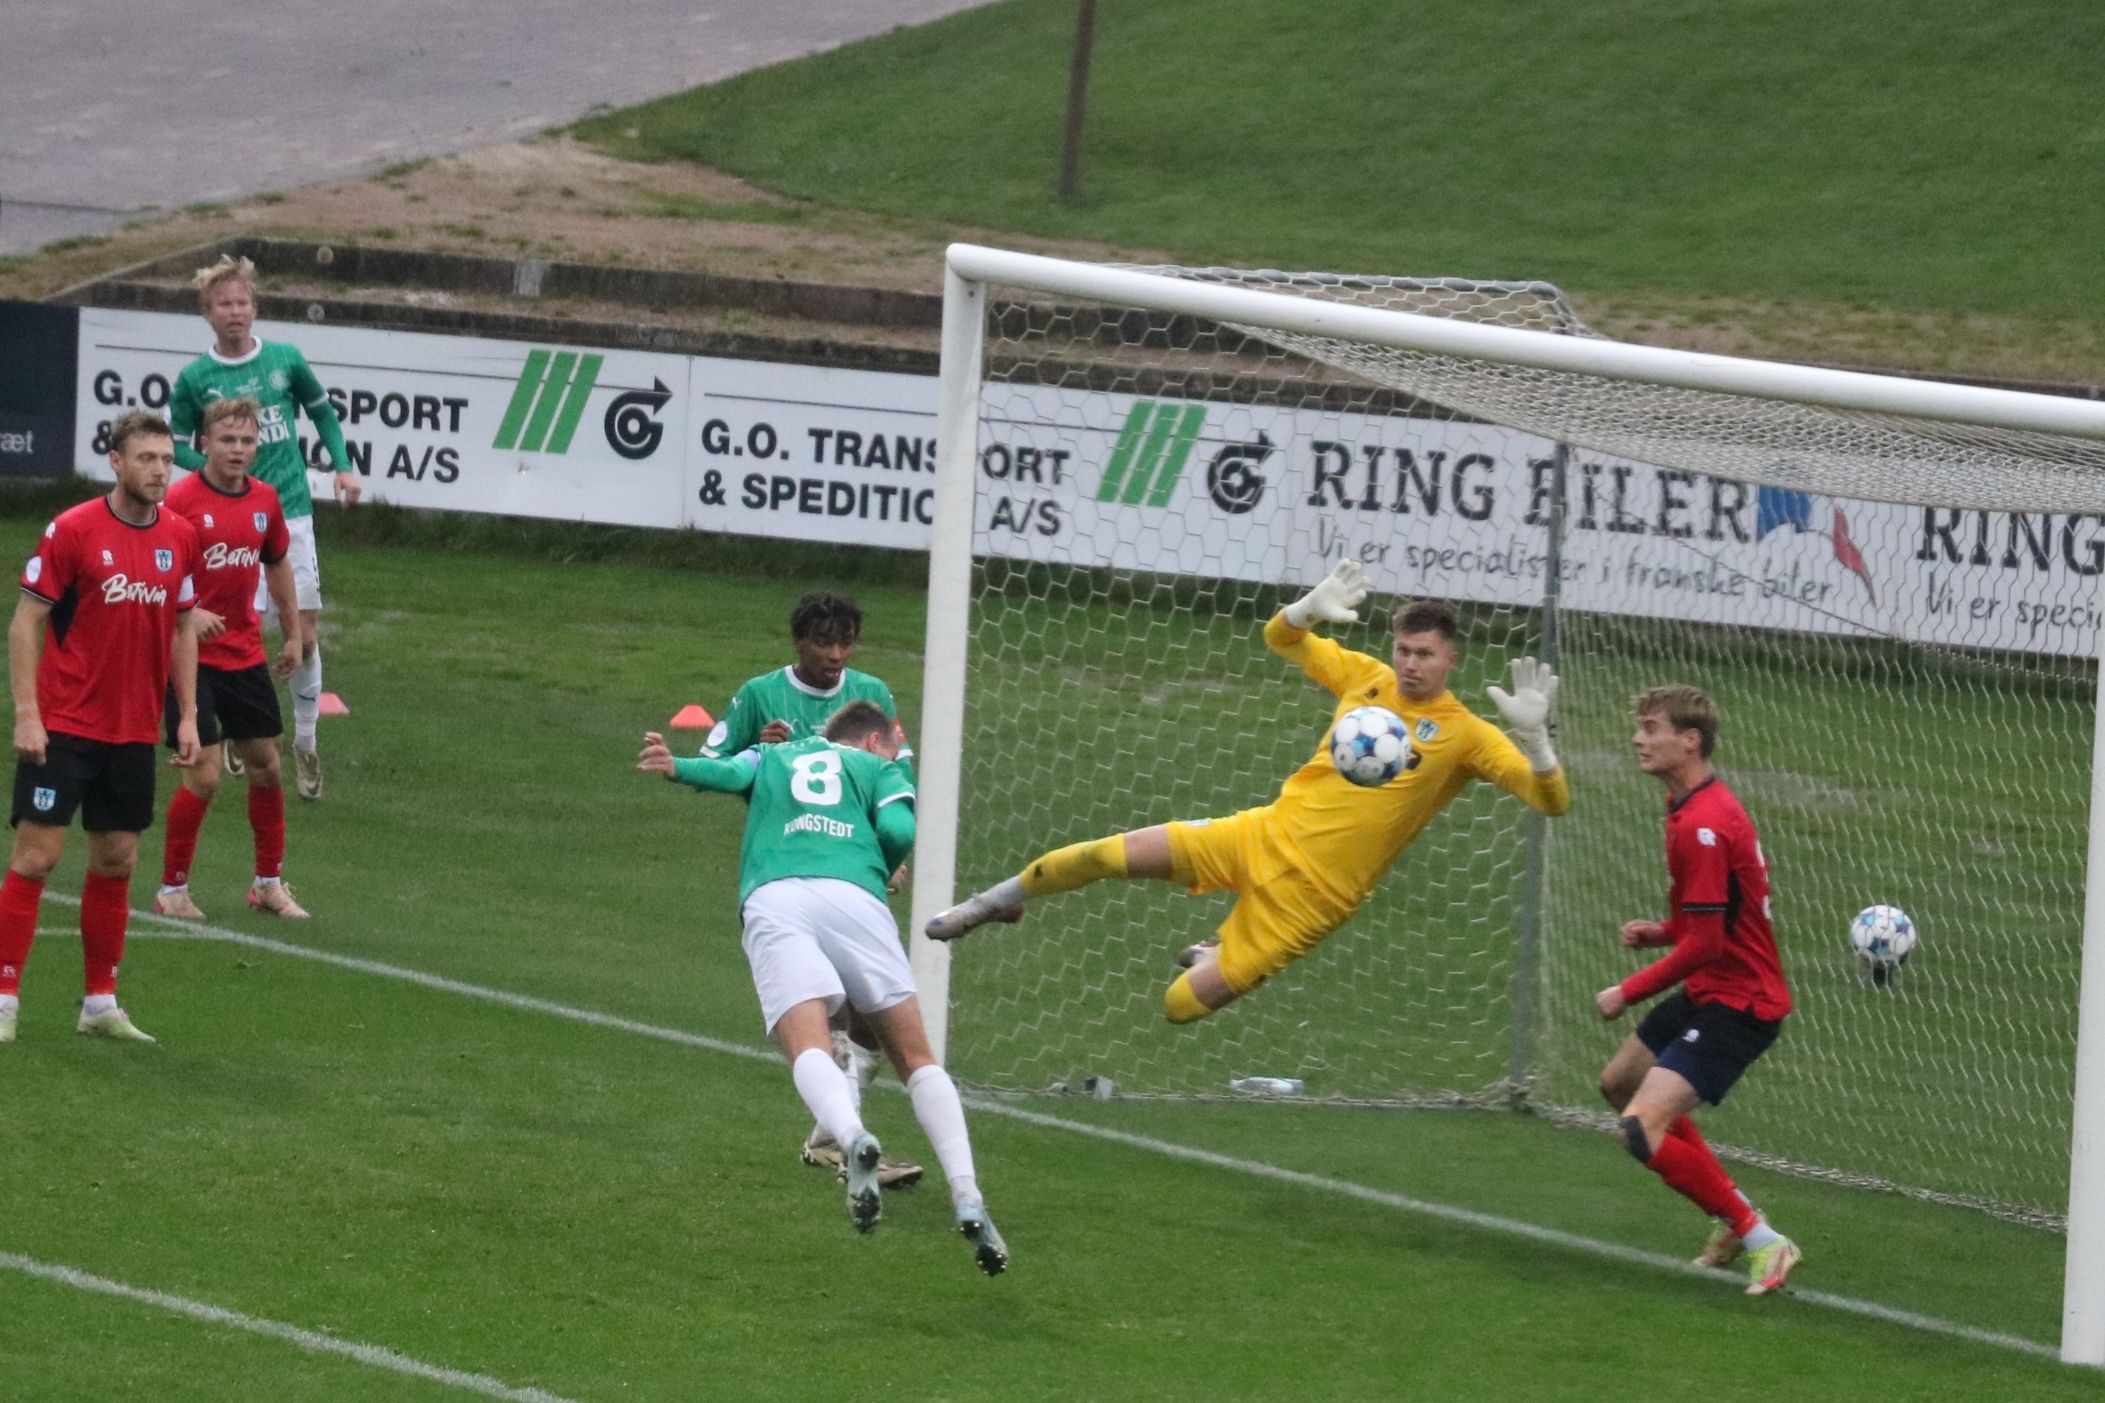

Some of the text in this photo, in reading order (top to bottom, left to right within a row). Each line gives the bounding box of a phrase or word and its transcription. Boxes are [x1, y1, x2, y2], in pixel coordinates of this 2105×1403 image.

[93, 369, 469, 433] G.O SPORT
[0, 431, 34, 454] æt
[387, 443, 460, 483] A/S
[701, 418, 790, 461] G.O.
[699, 469, 1061, 536] & SPEDITIO A/S
[1307, 440, 1496, 521] RING
[1319, 516, 1345, 559] Vi
[1360, 541, 1391, 564] er
[1916, 507, 2105, 576] RING
[1929, 572, 2103, 641] Vi er speci
[791, 750, 843, 806] 8
